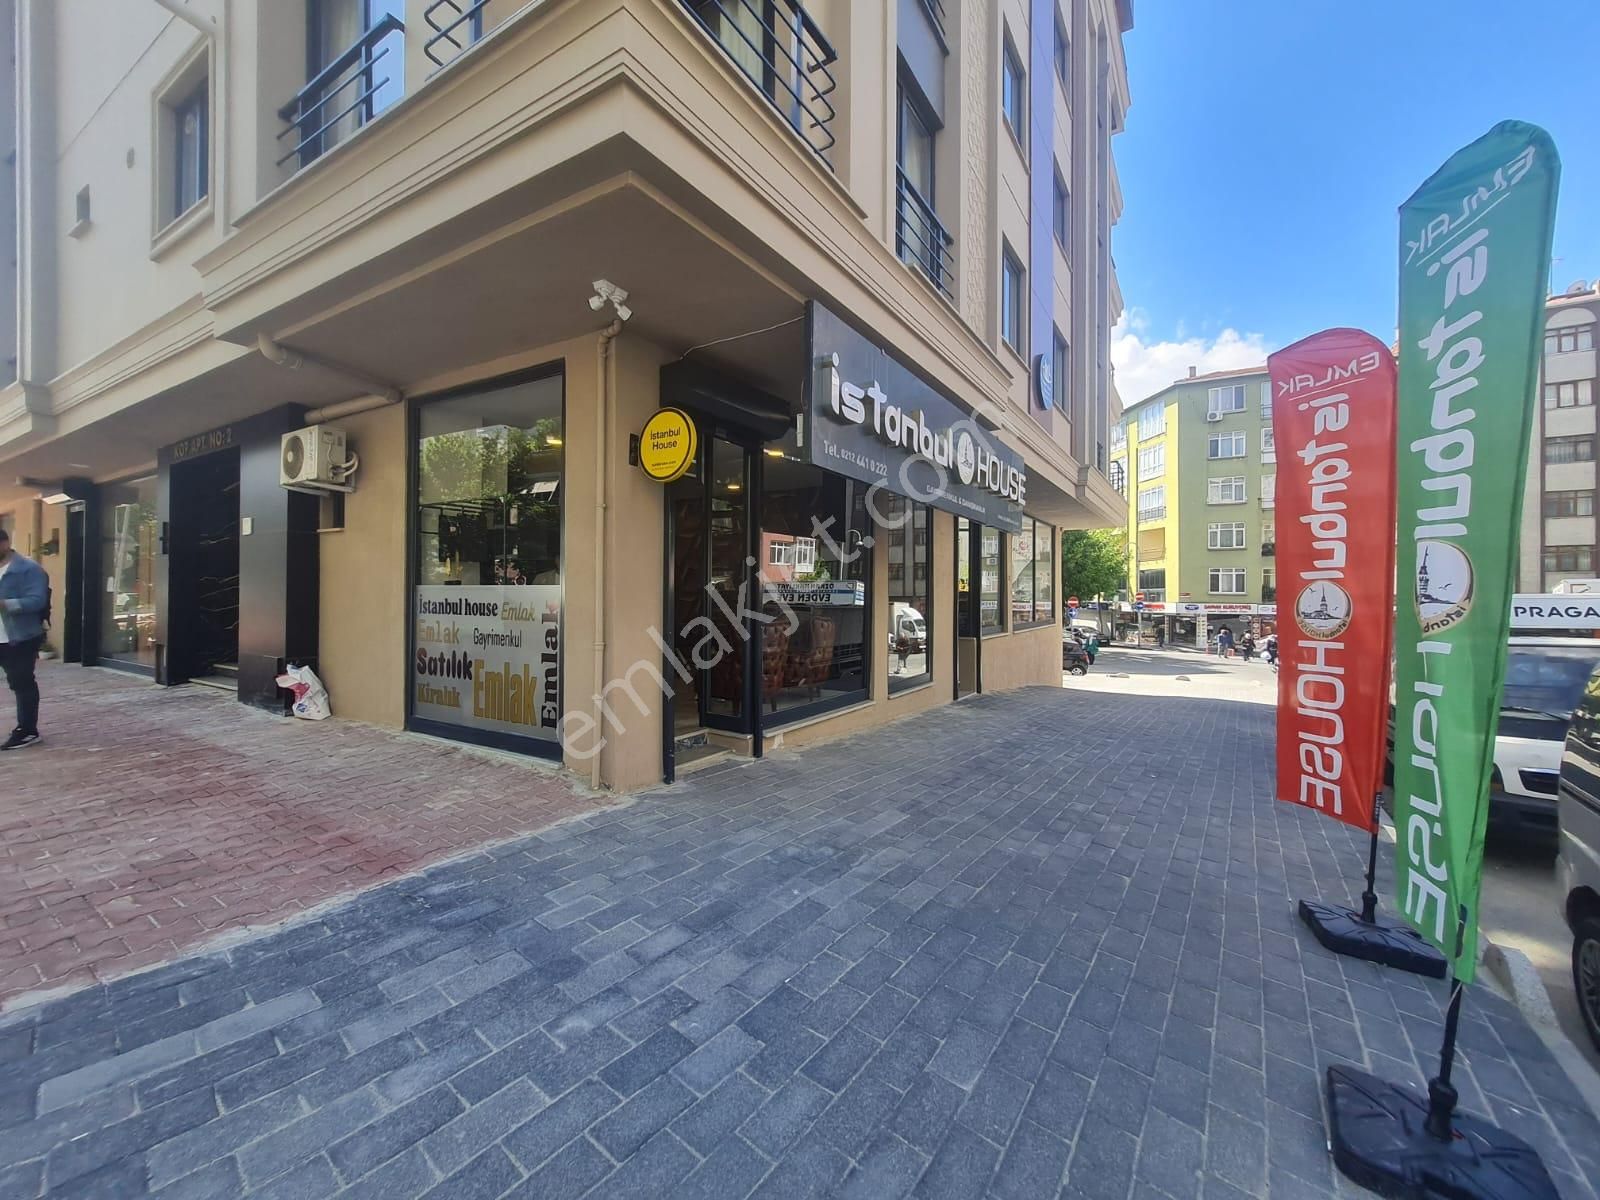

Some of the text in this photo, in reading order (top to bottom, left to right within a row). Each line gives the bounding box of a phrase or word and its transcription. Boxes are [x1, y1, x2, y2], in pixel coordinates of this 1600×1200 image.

[652, 440, 677, 450] House
[823, 440, 840, 459] Tel.
[840, 448, 856, 463] 0212
[856, 455, 869, 469] 441
[875, 461, 888, 476] 222
[977, 446, 1027, 506] HOUSE
[464, 598, 498, 617] house
[501, 601, 536, 622] Emlak
[1513, 606, 1600, 617] PRAGA
[417, 619, 522, 650] Emlak Gayrimenkul
[416, 648, 473, 681] Satılık
[541, 600, 559, 729] Emlak
[473, 658, 538, 727] Emlak
